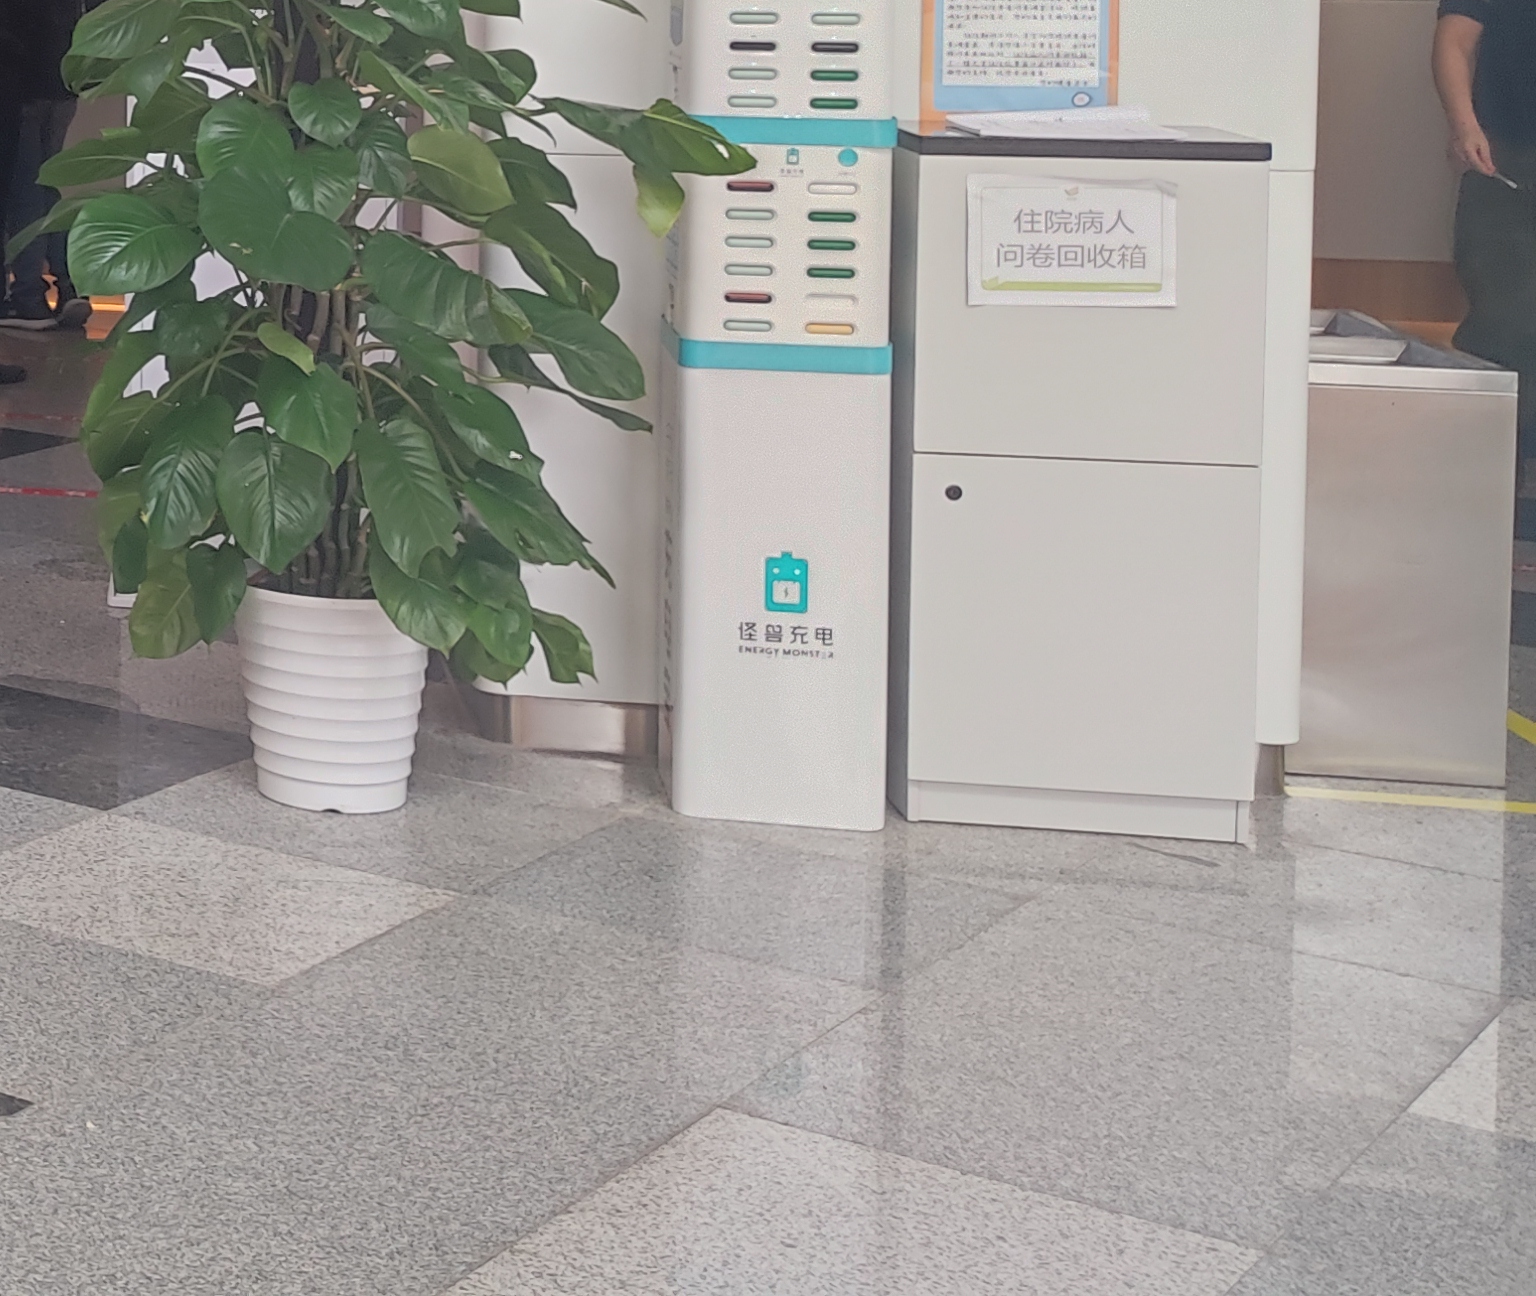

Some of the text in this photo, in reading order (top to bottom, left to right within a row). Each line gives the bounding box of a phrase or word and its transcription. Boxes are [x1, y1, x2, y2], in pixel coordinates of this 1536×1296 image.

[1013, 209, 1134, 234] 住院病人
[996, 243, 1147, 269] 问卷回收箱
[738, 622, 834, 646] 怪兽充电
[738, 645, 779, 657] ENERGY
